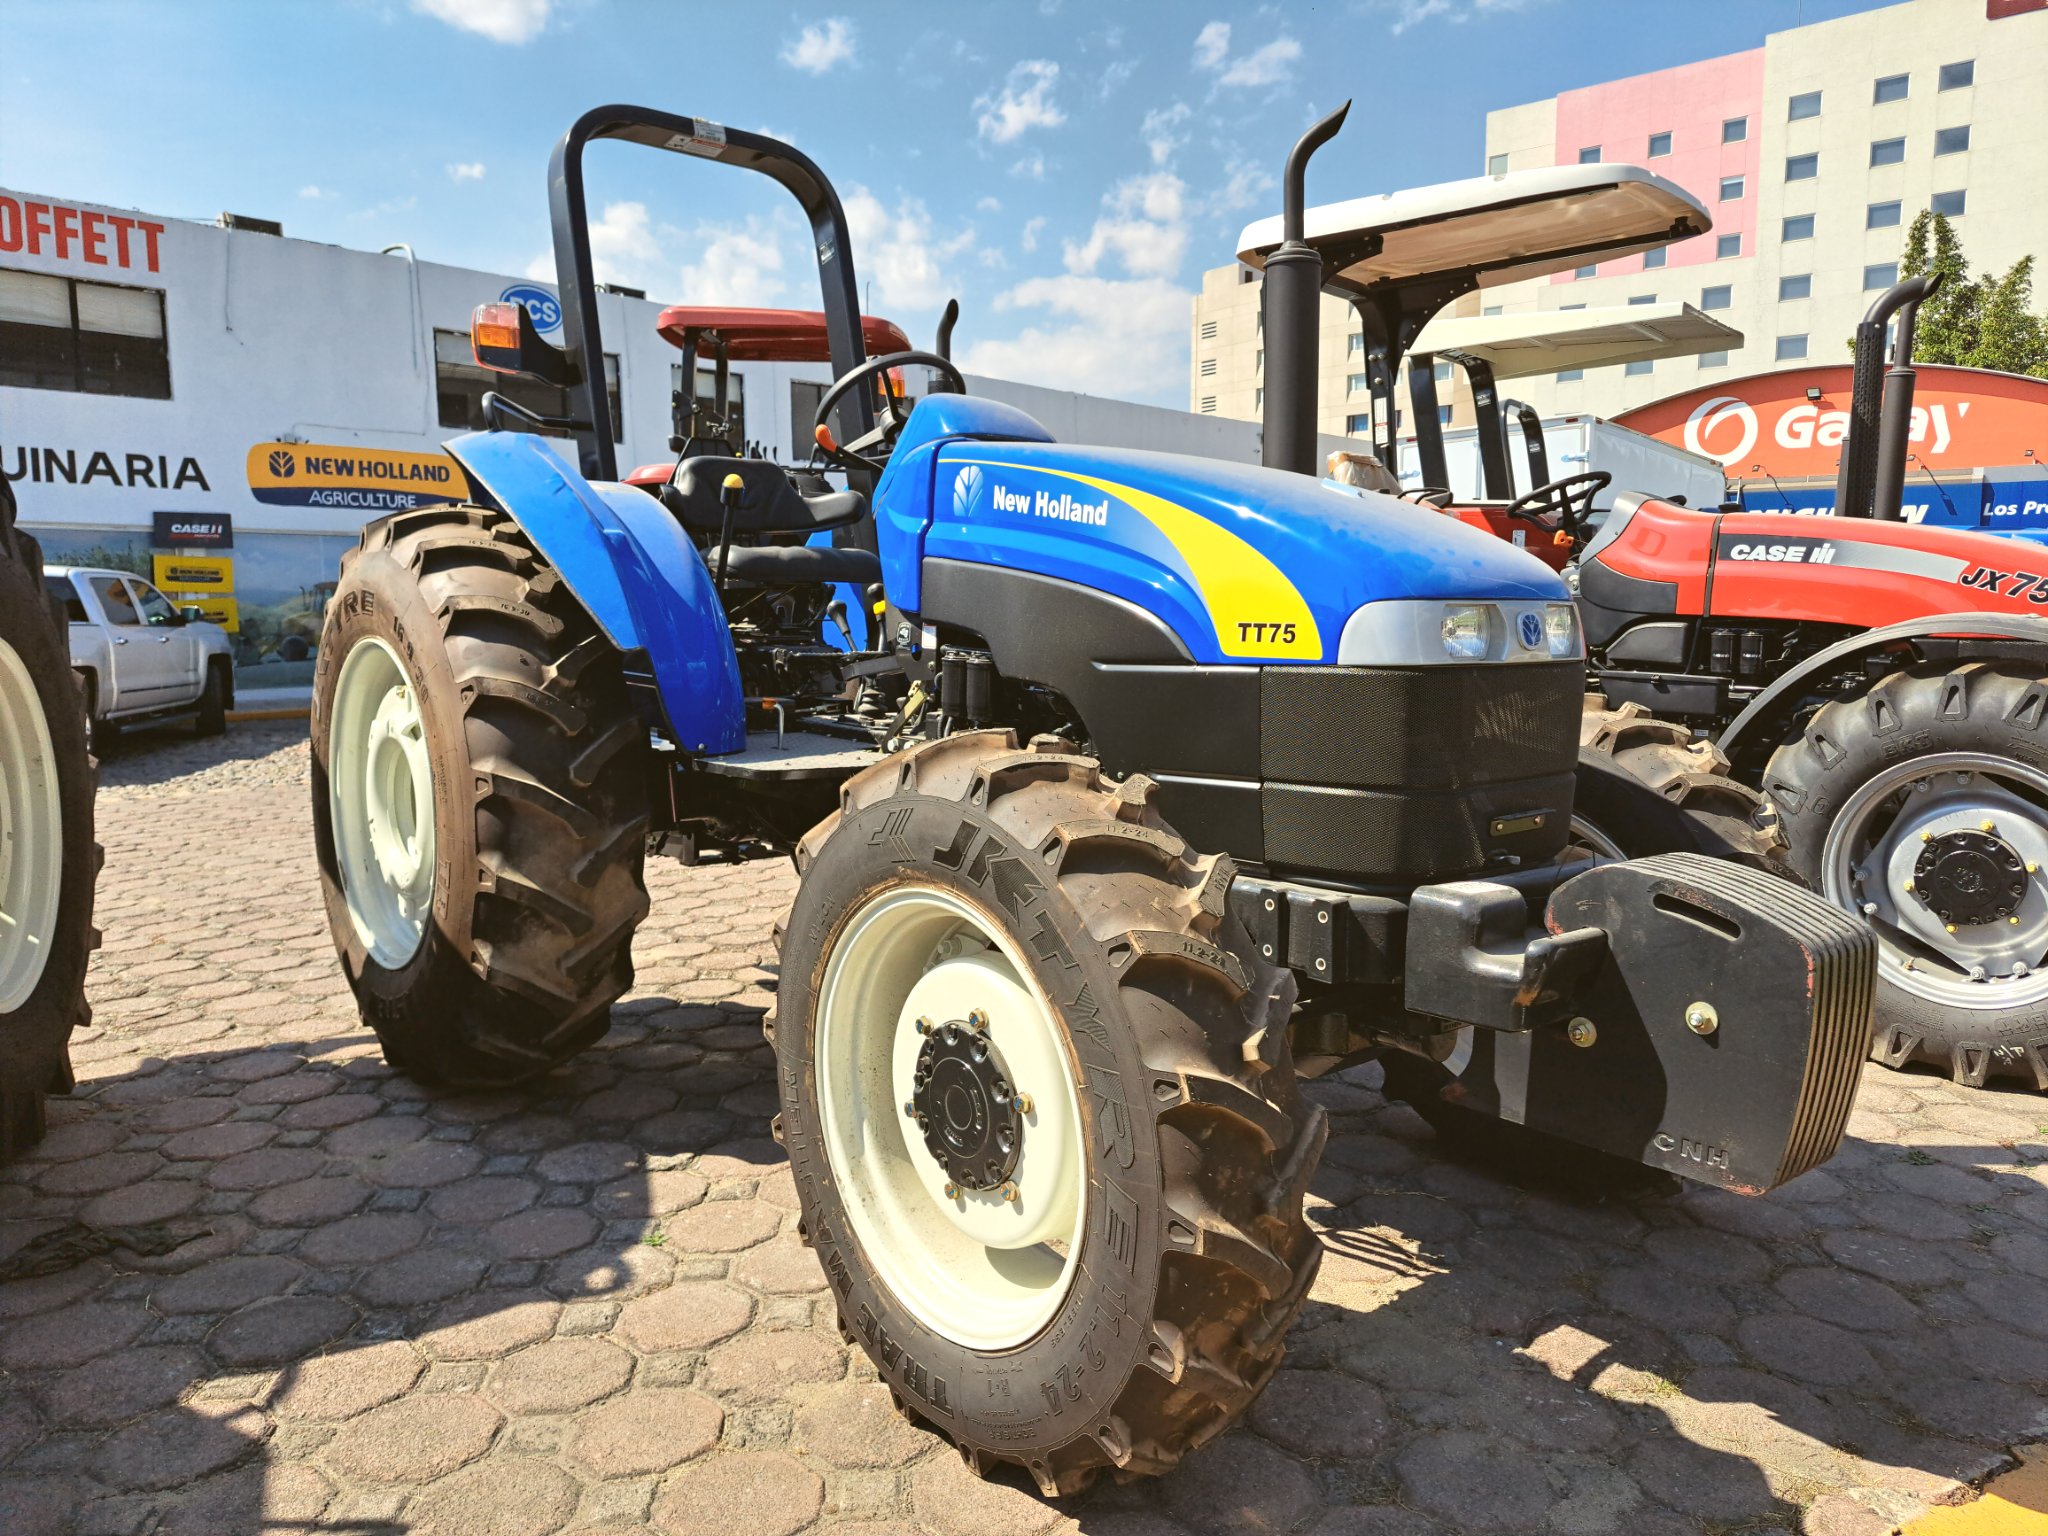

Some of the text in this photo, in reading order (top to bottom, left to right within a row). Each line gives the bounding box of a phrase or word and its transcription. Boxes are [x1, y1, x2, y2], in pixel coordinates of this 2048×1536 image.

[0, 196, 165, 273] OFFETT
[305, 456, 450, 483] NEW HOLLAND
[309, 490, 417, 508] AGRICULTURE
[993, 485, 1108, 526] New Holland
[1983, 501, 2048, 516] Los Pr
[171, 524, 210, 534] CASE
[1730, 544, 1806, 562] CASE
[1237, 623, 1296, 644] TT75
[1106, 823, 1149, 838] 11.2-24
[1653, 1132, 1729, 1169] CNH
[855, 1301, 954, 1418] TRAC
[1040, 1282, 1128, 1417] 11.2-24
